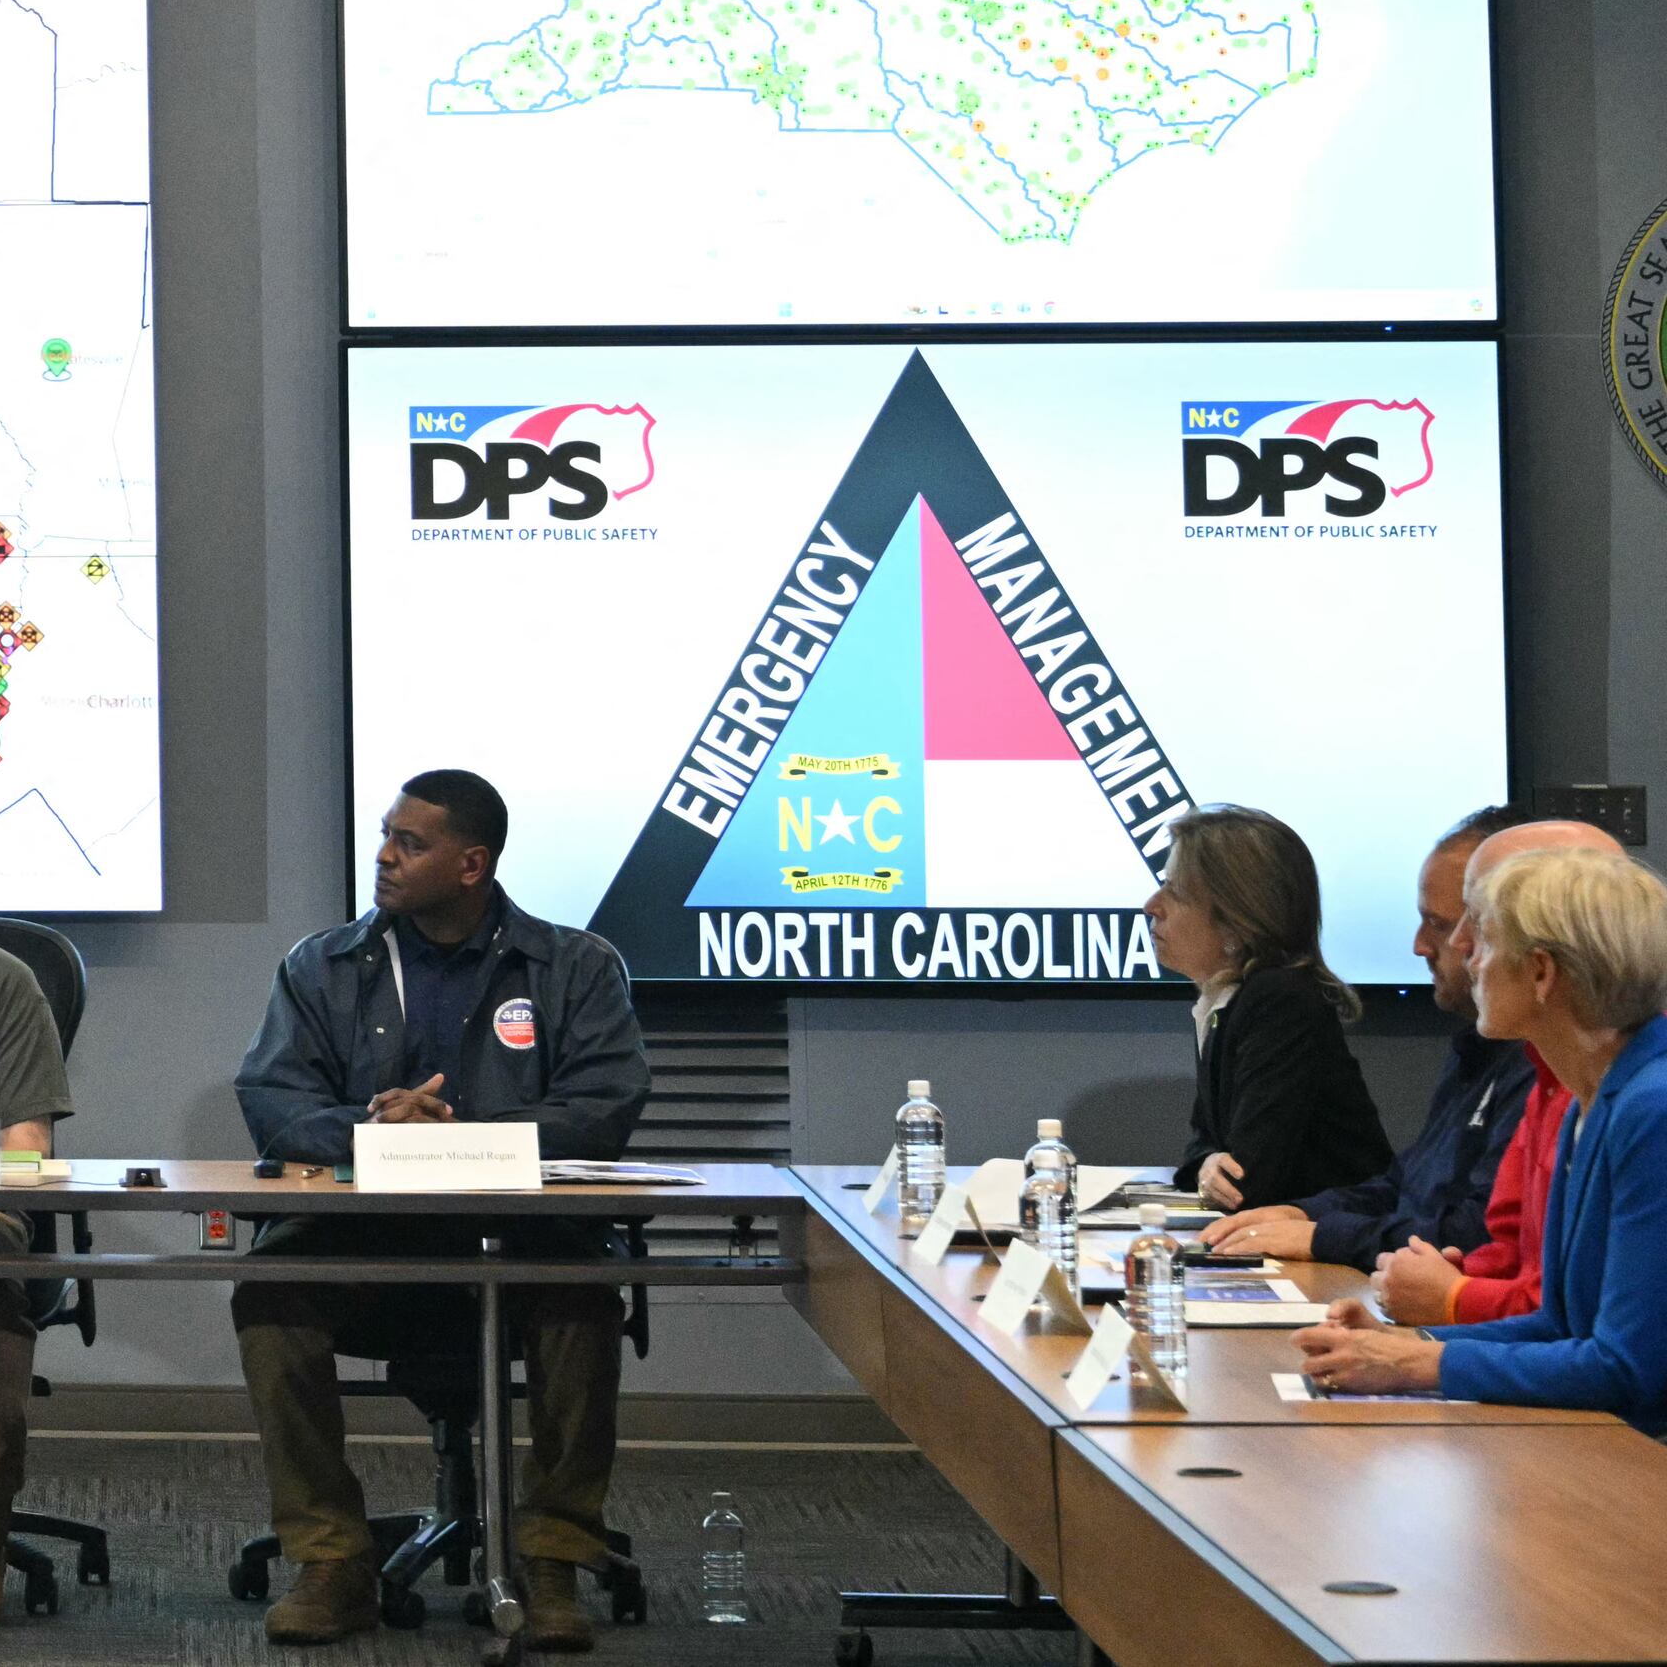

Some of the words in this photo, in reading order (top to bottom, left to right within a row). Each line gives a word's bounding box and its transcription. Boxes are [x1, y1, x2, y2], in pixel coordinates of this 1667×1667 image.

[1624, 291, 1655, 391] GREAT
[410, 441, 608, 521] DPS
[1182, 436, 1386, 518] DPS
[412, 529, 513, 541] DEPARTMENT
[519, 529, 538, 540] OF
[544, 529, 596, 540] PUBLIC
[602, 529, 658, 540] SAFETY
[1185, 526, 1289, 538] DEPARTMENT
[1295, 526, 1314, 537] OF
[1321, 526, 1375, 537] PUBLIC
[1380, 525, 1438, 537] SAFETY
[661, 520, 875, 839] EMERGENCY
[954, 511, 1190, 882] MANAGEMEN
[798, 757, 820, 769] MAY
[825, 760, 851, 771] 20TH
[855, 757, 878, 769] 1775
[779, 797, 811, 851] N
[863, 796, 903, 853] C
[795, 877, 828, 890] APRIL
[833, 875, 859, 886] 12TH
[865, 878, 887, 891] 1776
[699, 911, 874, 977] NORTH
[892, 912, 1161, 979] CAROLINA
[380, 1152, 443, 1161] Administrator
[446, 1151, 484, 1161] Michael
[487, 1152, 516, 1163] Regan
